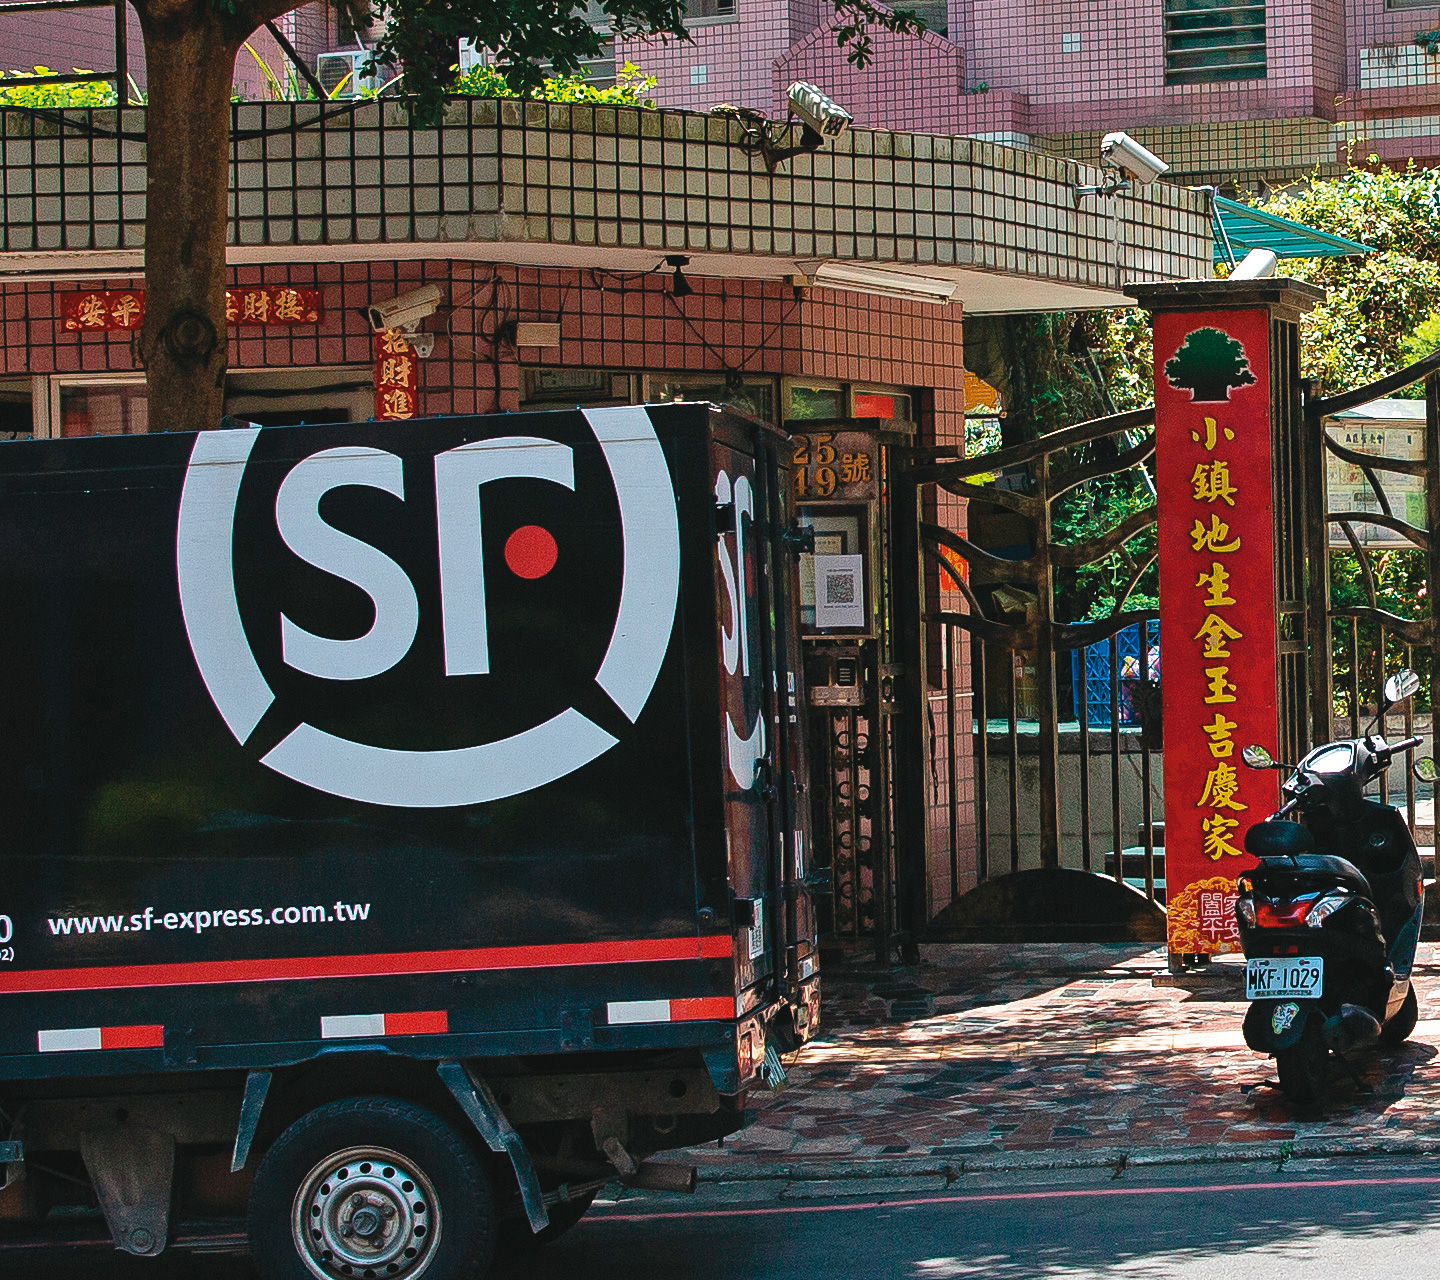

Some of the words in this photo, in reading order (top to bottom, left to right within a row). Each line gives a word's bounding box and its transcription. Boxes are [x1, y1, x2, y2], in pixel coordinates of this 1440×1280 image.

[793, 433, 835, 465] 25
[841, 452, 871, 483] 號
[1191, 417, 1248, 860] 小鎮地生金玉吉慶家
[47, 900, 371, 934] www.sf-express.com.tw
[1248, 967, 1320, 990] MKF-1029
